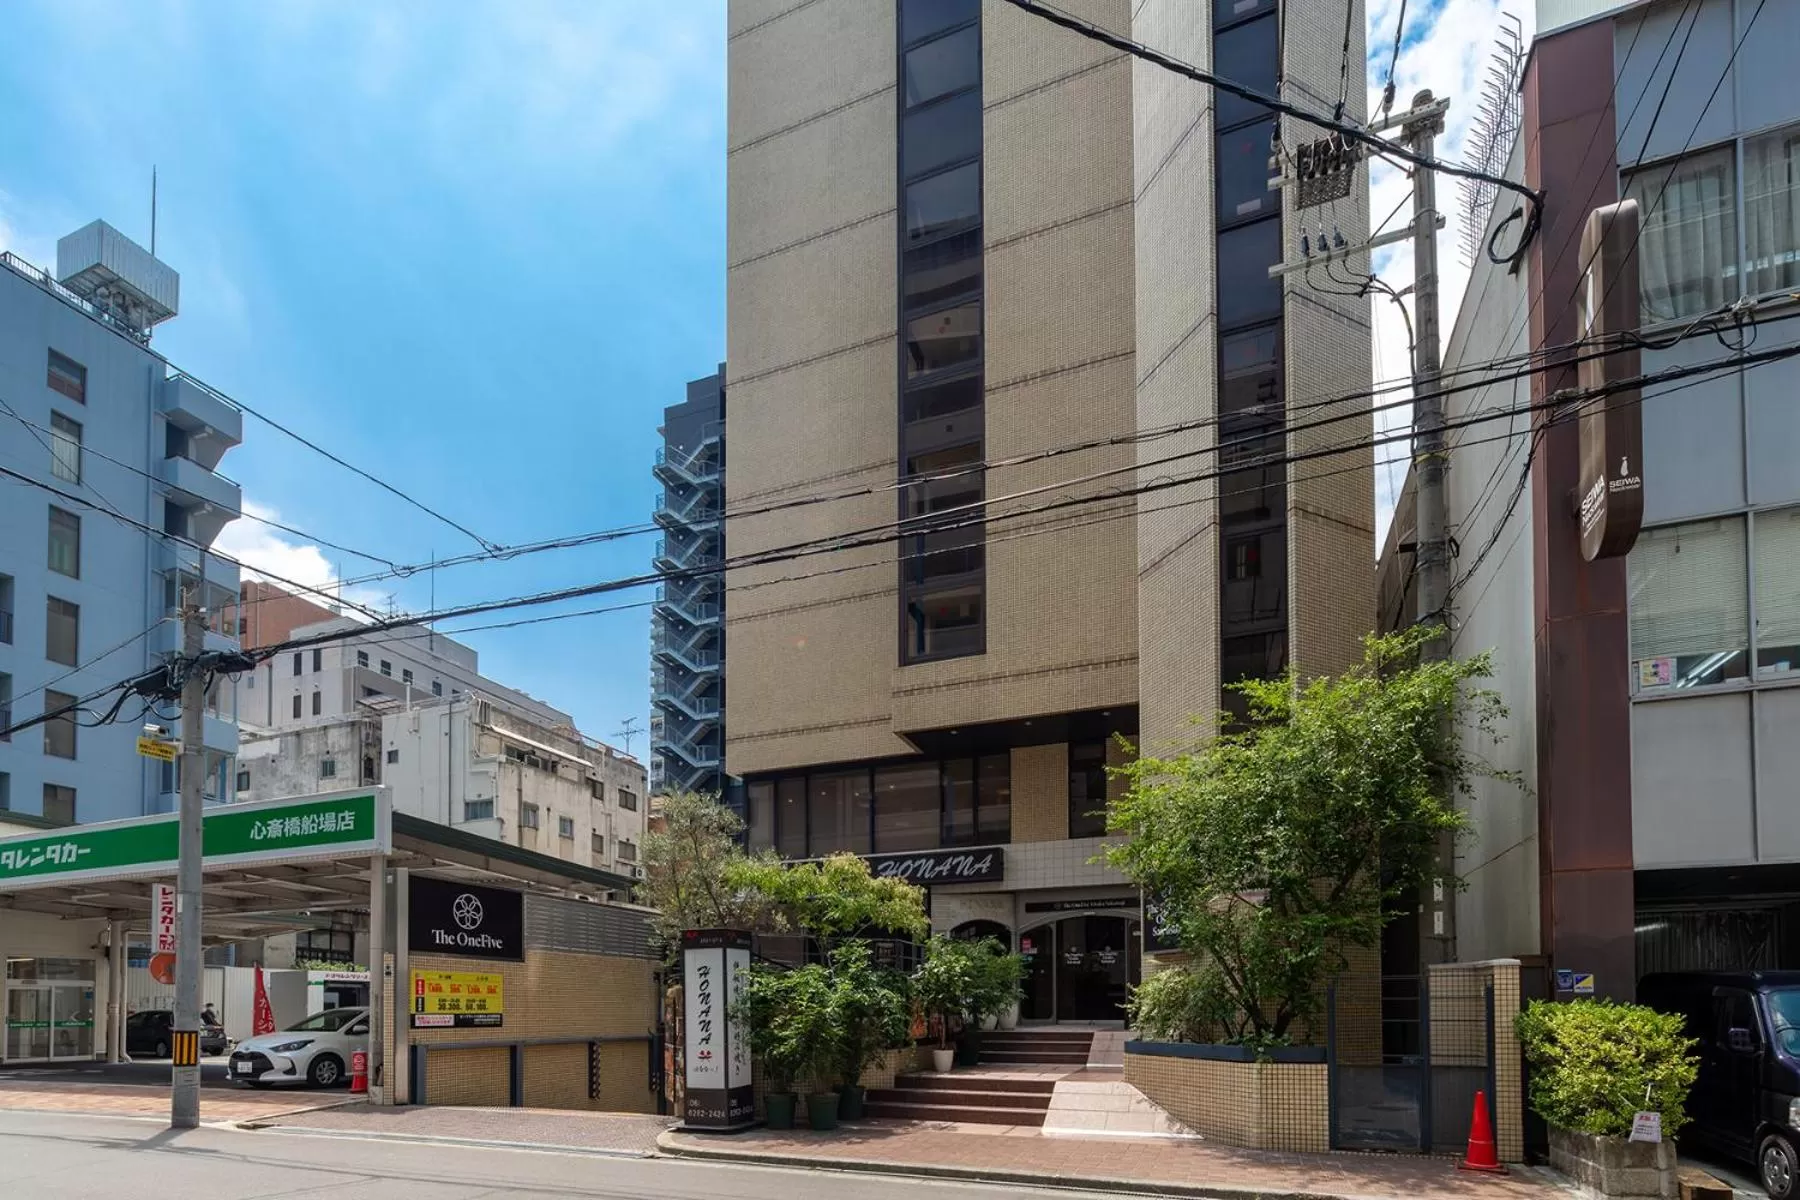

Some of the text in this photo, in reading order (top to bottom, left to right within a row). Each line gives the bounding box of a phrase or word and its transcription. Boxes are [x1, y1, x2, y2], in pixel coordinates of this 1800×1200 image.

[1582, 474, 1605, 515] SEIWA
[1609, 476, 1641, 488] SEIWA
[250, 810, 356, 840] 心斎橋船場店
[877, 854, 993, 879] HONANA
[431, 929, 504, 949] The OneFive
[697, 965, 712, 1045] HONANA
